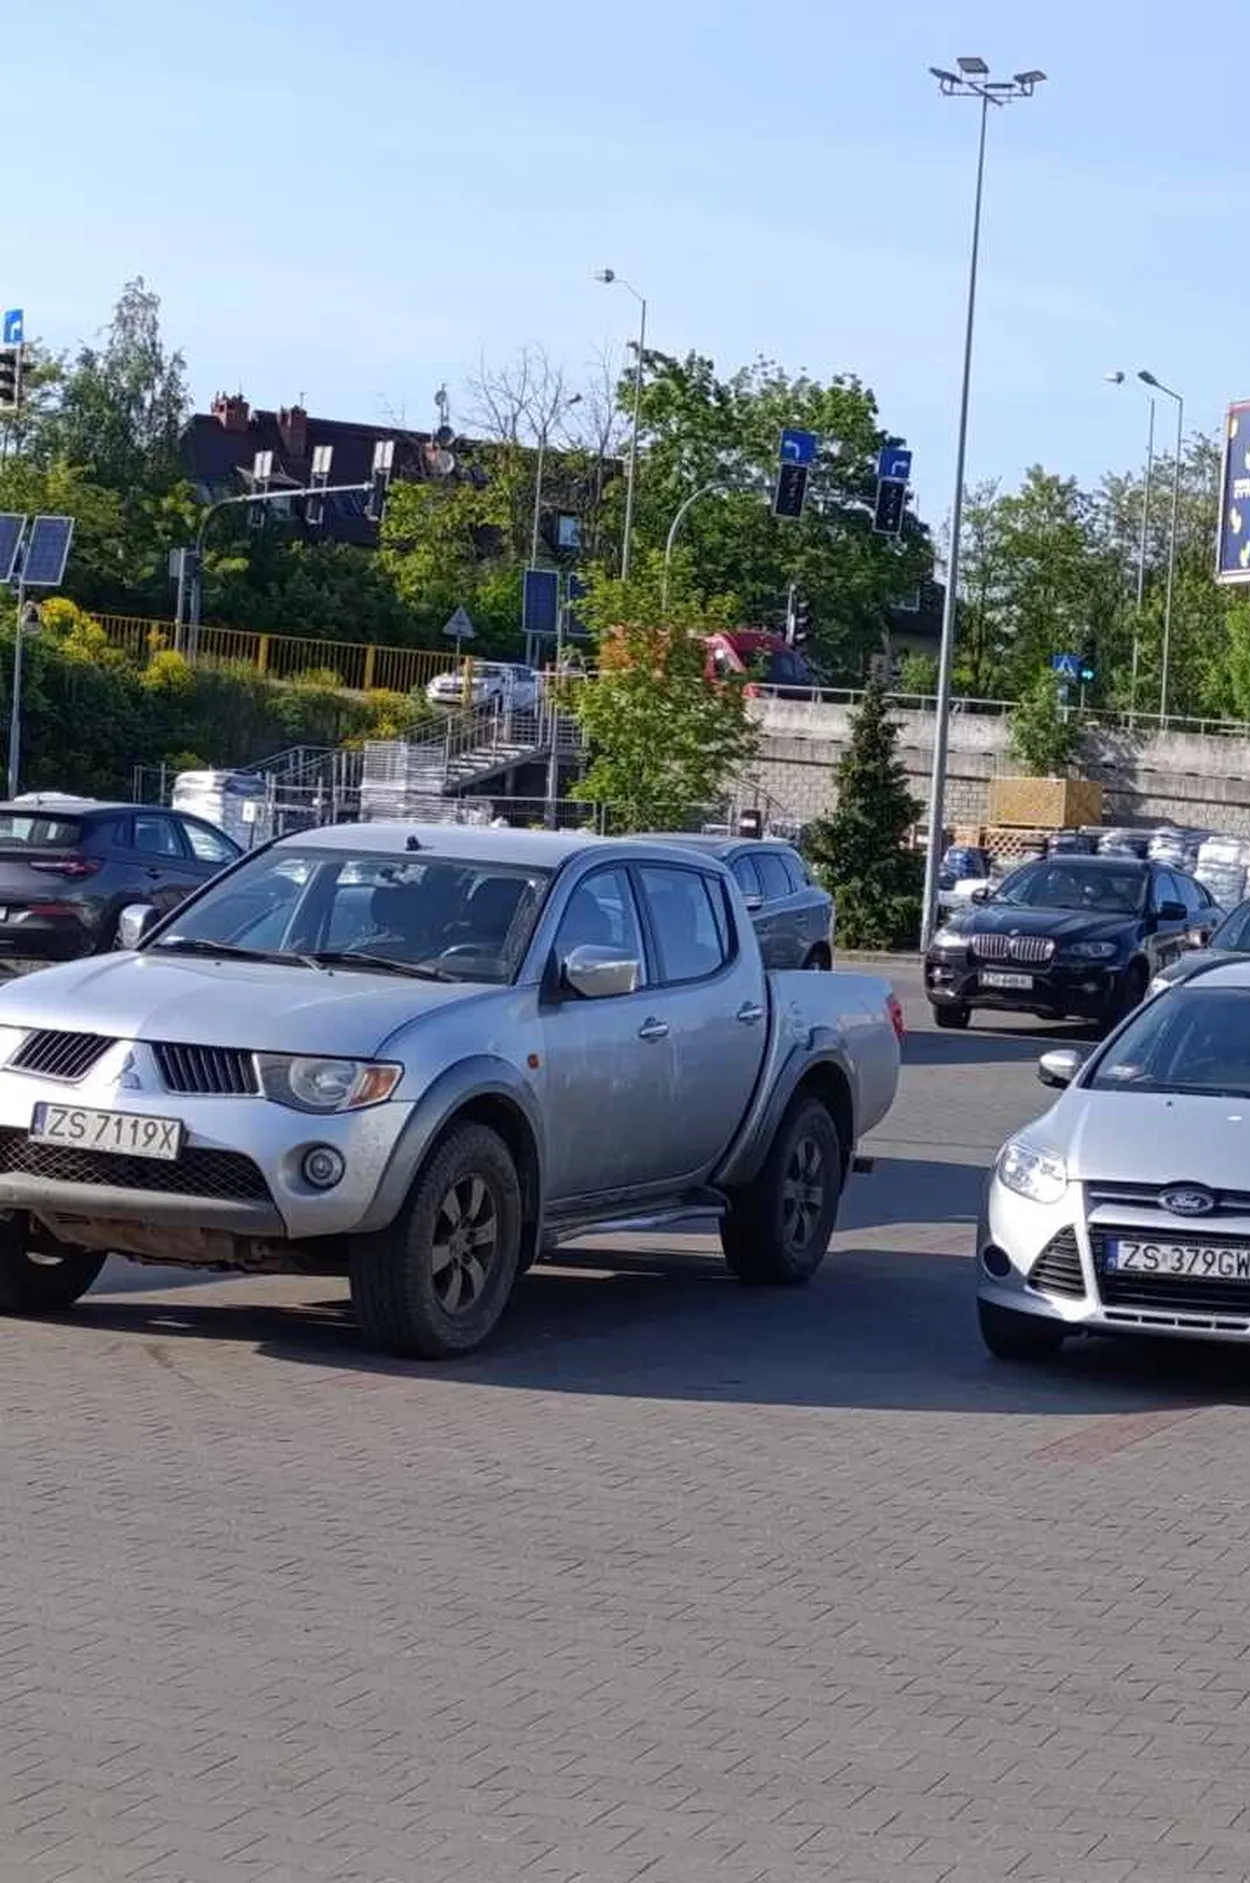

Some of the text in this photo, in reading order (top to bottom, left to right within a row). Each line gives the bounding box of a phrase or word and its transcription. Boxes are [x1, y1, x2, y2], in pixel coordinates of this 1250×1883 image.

[50, 1108, 176, 1150] ZS 7119X
[1122, 1241, 1250, 1279] ZS 379GW
